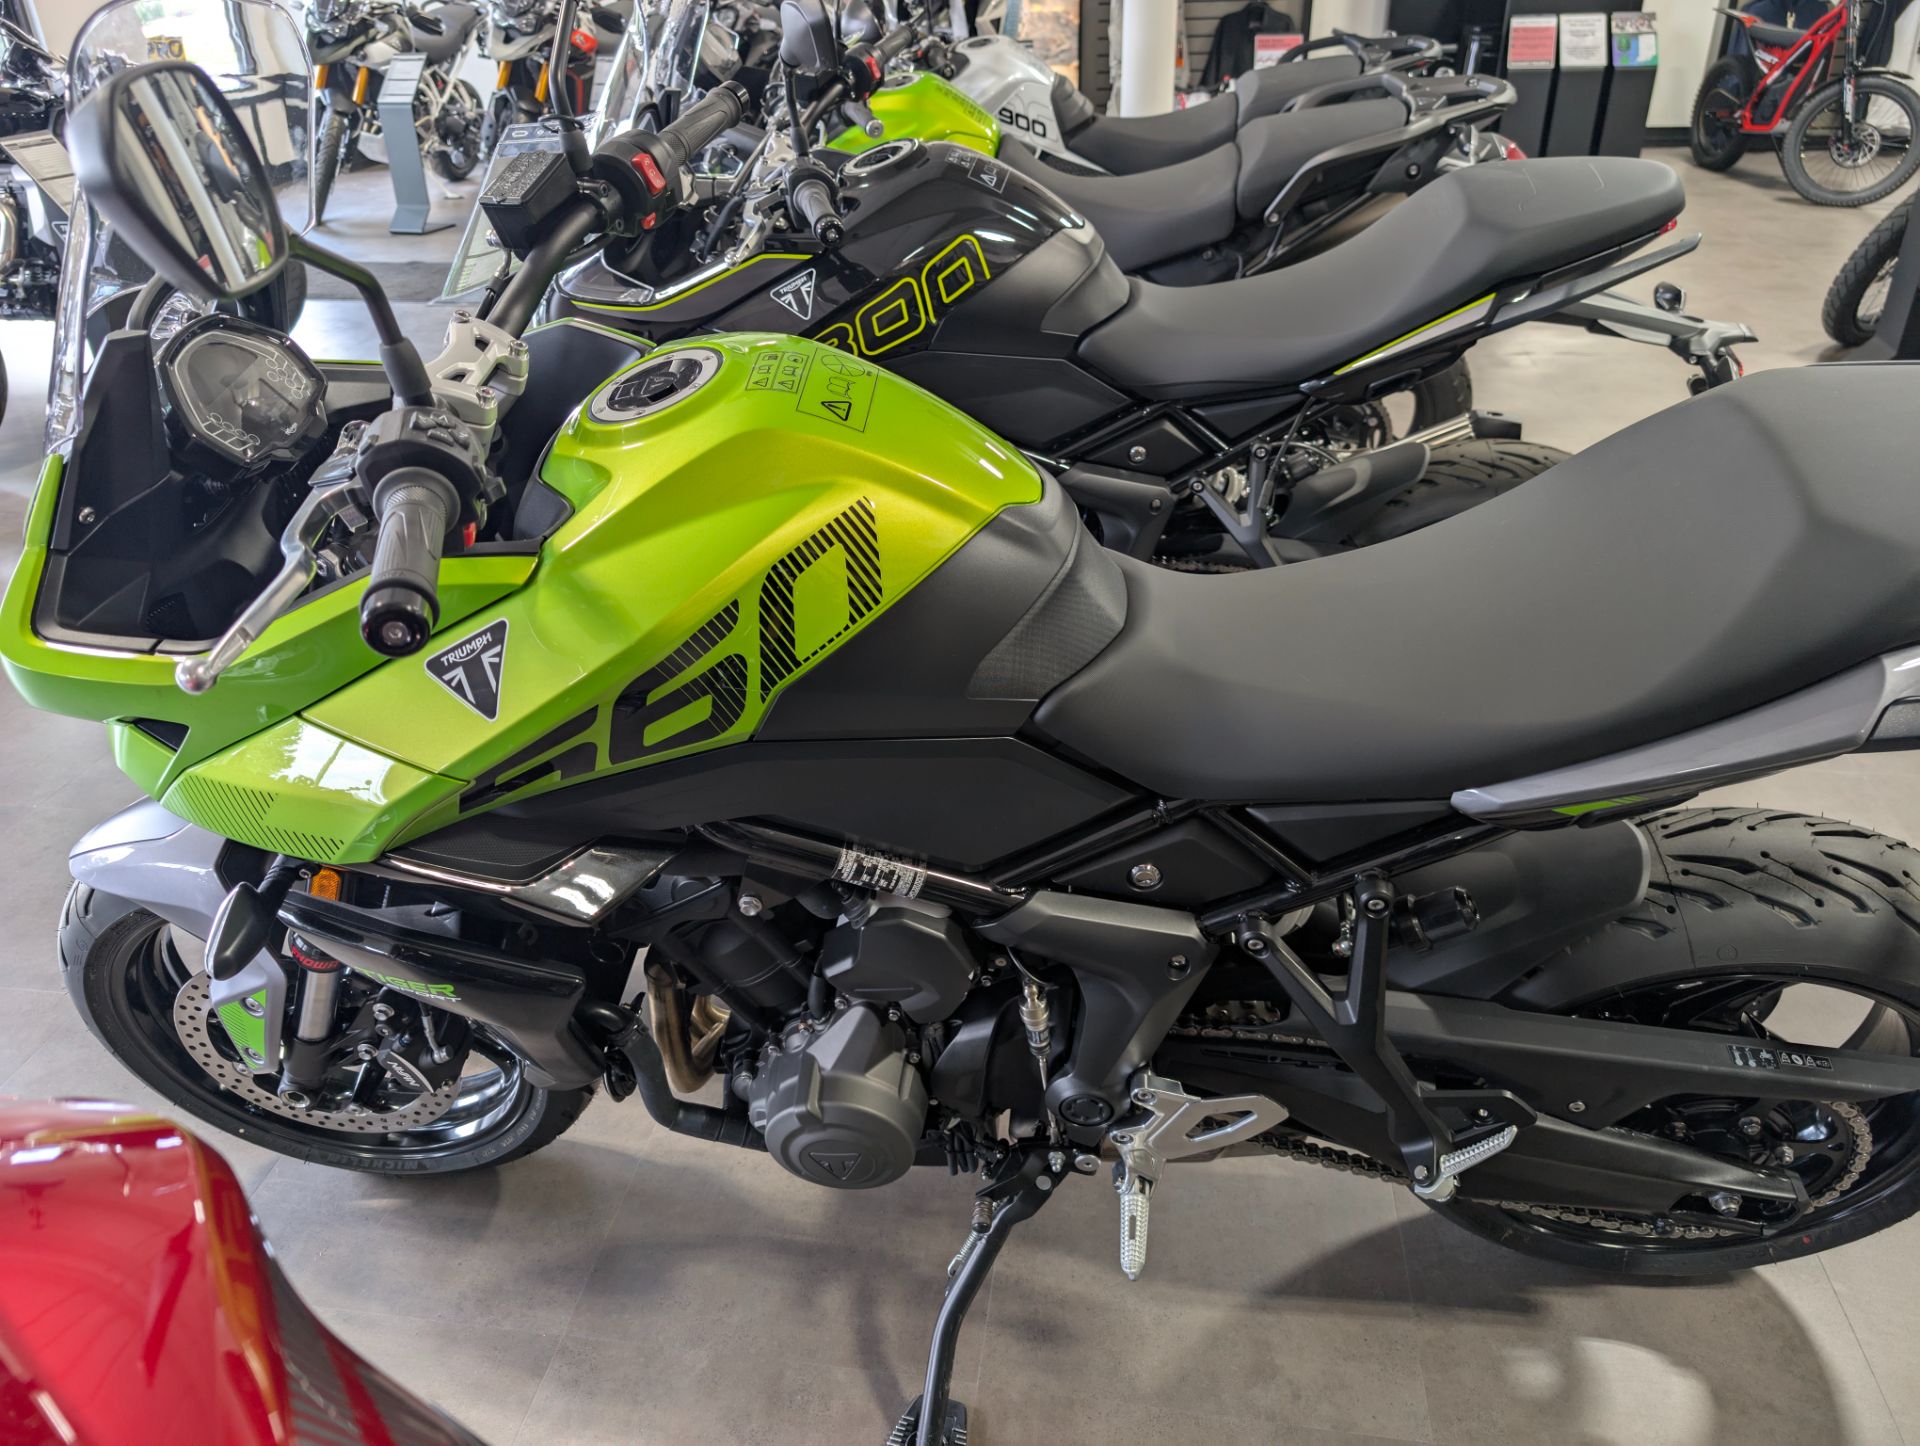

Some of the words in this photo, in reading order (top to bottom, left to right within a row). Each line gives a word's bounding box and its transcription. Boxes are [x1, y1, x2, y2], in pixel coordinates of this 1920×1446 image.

[998, 107, 1046, 138] 900
[780, 275, 807, 294] TRIUMPH
[440, 631, 493, 667] TRIUMPH
[356, 966, 457, 998] TIGER
